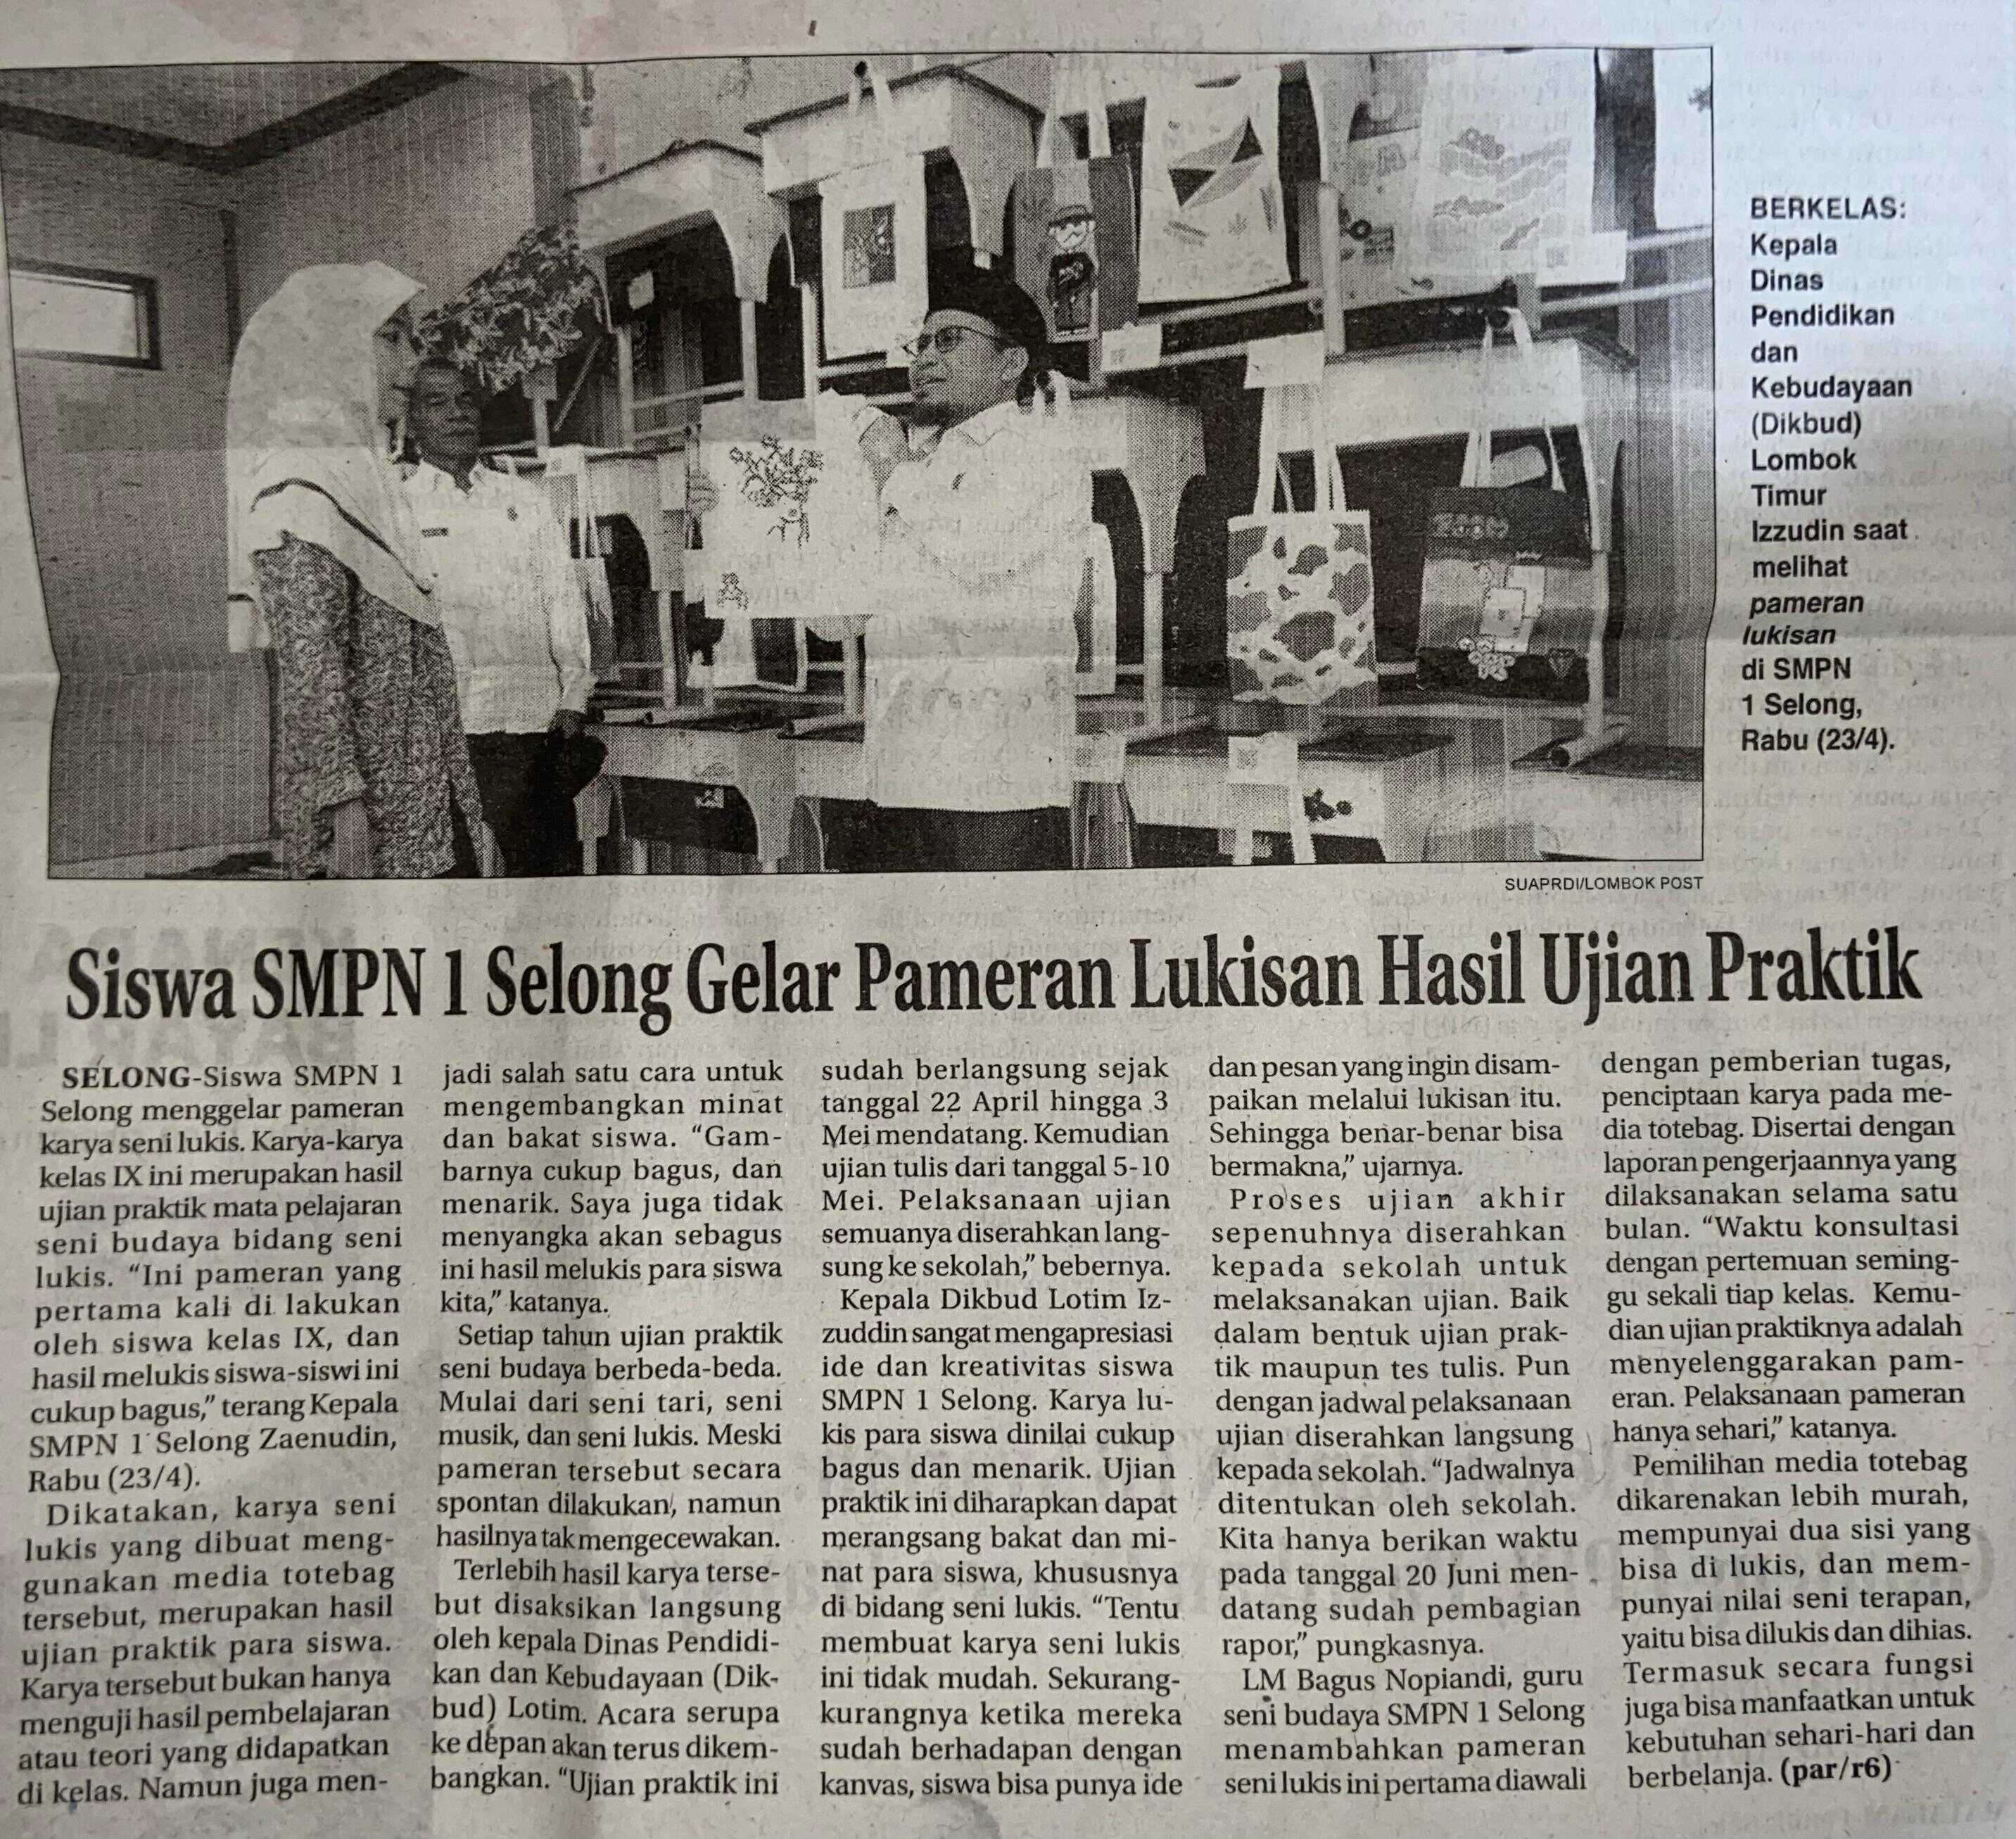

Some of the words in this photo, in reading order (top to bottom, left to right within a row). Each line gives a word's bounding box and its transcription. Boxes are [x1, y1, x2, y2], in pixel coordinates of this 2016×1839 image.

[1751, 196, 1906, 219] BERKELAS:
[1751, 233, 1837, 262] Kepala
[1751, 269, 1824, 292] Dinas
[1751, 303, 1895, 328] Pendidikan
[1751, 340, 1798, 364] dan
[1751, 374, 1913, 404] Kebudayaan
[1752, 411, 1862, 440] (Dikbud)
[1751, 446, 1858, 471] Lombok
[1750, 483, 1827, 507] Timur
[1752, 518, 1844, 542] Izzudin
[1853, 518, 1908, 541] saat
[1753, 554, 1849, 578] melihat
[1749, 595, 1865, 620] pameran
[1742, 624, 1837, 646] lukisan
[1742, 657, 1764, 680] di
[1773, 656, 1851, 680] SMPN
[1742, 694, 1753, 716] 1
[1764, 692, 1863, 721] Selong,
[1742, 728, 1809, 751] Rabu
[1817, 726, 1895, 756] (23/4).
[1504, 877, 1656, 891] SUAPRDI/LOMBOK
[1660, 876, 1704, 890] POST
[67, 947, 237, 1020] Siswa
[253, 948, 426, 1019] SMPN
[443, 948, 468, 1016] 1
[486, 941, 673, 1037] Selong
[686, 939, 841, 1014] Gelar
[854, 942, 1117, 1012] Pameran
[1129, 933, 1364, 1009] Lukisan
[1376, 929, 1526, 1006] Hasil
[1539, 929, 1695, 1026] Ujian
[1705, 925, 1923, 1003] Praktik
[63, 1065, 282, 1089] SELONG-Siswa
[295, 1064, 379, 1087] SMPN
[392, 1064, 402, 1086] 1
[821, 1057, 904, 1081] sudah
[915, 1057, 1087, 1086] berlangsung
[1098, 1055, 1169, 1085] sejak
[1601, 1051, 1699, 1080] dengan
[1710, 1049, 1860, 1079] pemberian
[1870, 1051, 1951, 1077] tugas,
[443, 1093, 685, 1123] mengembangkan
[699, 1090, 784, 1114] minat
[821, 1090, 920, 1120] tanggal
[931, 1091, 961, 1112] 22
[972, 1088, 1039, 1119] April
[1050, 1089, 1142, 1118] hingga
[1153, 1090, 1168, 1111] 3
[1210, 1121, 1331, 1150] Sehingga
[1339, 1119, 1502, 1144] benar-benar
[1510, 1119, 1564, 1142] bisa
[39, 1165, 106, 1188] kelas
[113, 1165, 144, 1187] IX
[148, 1164, 183, 1186] ini
[189, 1162, 339, 1191] merupakan
[344, 1159, 403, 1183] hasil
[1603, 1150, 1699, 1180] laporan
[1701, 1149, 1891, 1178] pengerjaannya
[1894, 1153, 1957, 1177] yang
[442, 1190, 559, 1214] menarik.
[571, 1192, 631, 1221] Saya
[642, 1192, 702, 1220] juga
[713, 1189, 784, 1212] tidak
[822, 1227, 953, 1250] semuanya
[957, 1220, 1100, 1244] diserahkan
[1104, 1220, 1170, 1249] lang-
[1212, 1221, 1393, 1252] sepenuhnya
[1406, 1218, 1566, 1244] diserahkan
[1604, 1216, 1689, 1240] bulan.
[1815, 1214, 1959, 1237] konsultasi
[36, 1265, 113, 1289] lukis.
[195, 1266, 324, 1292] pameran
[335, 1264, 402, 1289] yang
[509, 1290, 609, 1320] katanya.
[1606, 1290, 1639, 1314] gu
[1647, 1283, 1718, 1306] sekali
[1725, 1283, 1774, 1311] tiap
[1782, 1281, 1854, 1304] kelas.
[1872, 1282, 1961, 1304] Kemu-
[1214, 1321, 1300, 1345] dalam
[1311, 1322, 1411, 1348] bentuk
[1419, 1322, 1489, 1352] ujian
[1499, 1319, 1568, 1350] prak-
[821, 1354, 864, 1377] ide
[877, 1354, 928, 1377] dan
[941, 1354, 1086, 1377] kreativitas
[1098, 1354, 1174, 1377] siswa
[30, 1400, 115, 1429] cukup
[222, 1399, 306, 1423] terang
[310, 1390, 399, 1421] Kepala
[1215, 1388, 1314, 1419] dengan
[1318, 1390, 1407, 1420] jadwal
[1411, 1389, 1572, 1420] pelaksanaan
[438, 1422, 519, 1449] musik,
[527, 1423, 571, 1446] dan
[577, 1426, 626, 1449] seni
[633, 1423, 699, 1448] lukis.
[706, 1422, 782, 1446] Meski
[1612, 1419, 1690, 1449] hanya
[1789, 1415, 1897, 1445] katanya.
[27, 1468, 100, 1493] Rabu
[108, 1463, 200, 1494] (23/4).
[821, 1455, 900, 1486] bagus
[911, 1455, 961, 1480] dan
[972, 1456, 1091, 1480] menarik.
[1102, 1456, 1176, 1487] Ujian
[1216, 1456, 1313, 1487] kepada
[1317, 1458, 1426, 1484] sekolah.
[436, 1523, 538, 1553] hasilnya
[541, 1525, 576, 1549] tak
[578, 1525, 780, 1558] mengecewakan.
[23, 1569, 158, 1603] gunakan
[173, 1563, 270, 1590] media
[283, 1560, 395, 1591] totebag
[1219, 1560, 1287, 1591] pada
[1298, 1563, 1397, 1593] tanggal
[1405, 1564, 1437, 1586] 20
[1447, 1561, 1501, 1589] Juni
[1509, 1565, 1579, 1584] men-
[821, 1593, 845, 1617] di
[855, 1593, 944, 1625] bidang
[953, 1595, 1006, 1619] seni
[1015, 1594, 1082, 1619] lukis.
[1621, 1590, 1713, 1622] punyai
[1723, 1586, 1782, 1612] nilai
[1793, 1586, 1849, 1610] seni
[1858, 1589, 1971, 1614] terapan,
[1316, 1633, 1484, 1664] pungkasnya.
[20, 1677, 99, 1706] Karya
[106, 1670, 217, 1697] tersebut
[222, 1666, 305, 1692] bukan
[310, 1664, 391, 1694] hanya
[432, 1660, 481, 1686] kan
[490, 1660, 538, 1684] dan
[545, 1662, 704, 1696] Kebudayaan
[714, 1662, 779, 1693] (Dik-
[431, 1764, 550, 1795] bangkan.
[642, 1769, 737, 1802] praktik
[744, 1771, 779, 1795] ini
[1627, 1761, 1773, 1791] berbelanja.
[1780, 1753, 1891, 1788] (par/r6)
